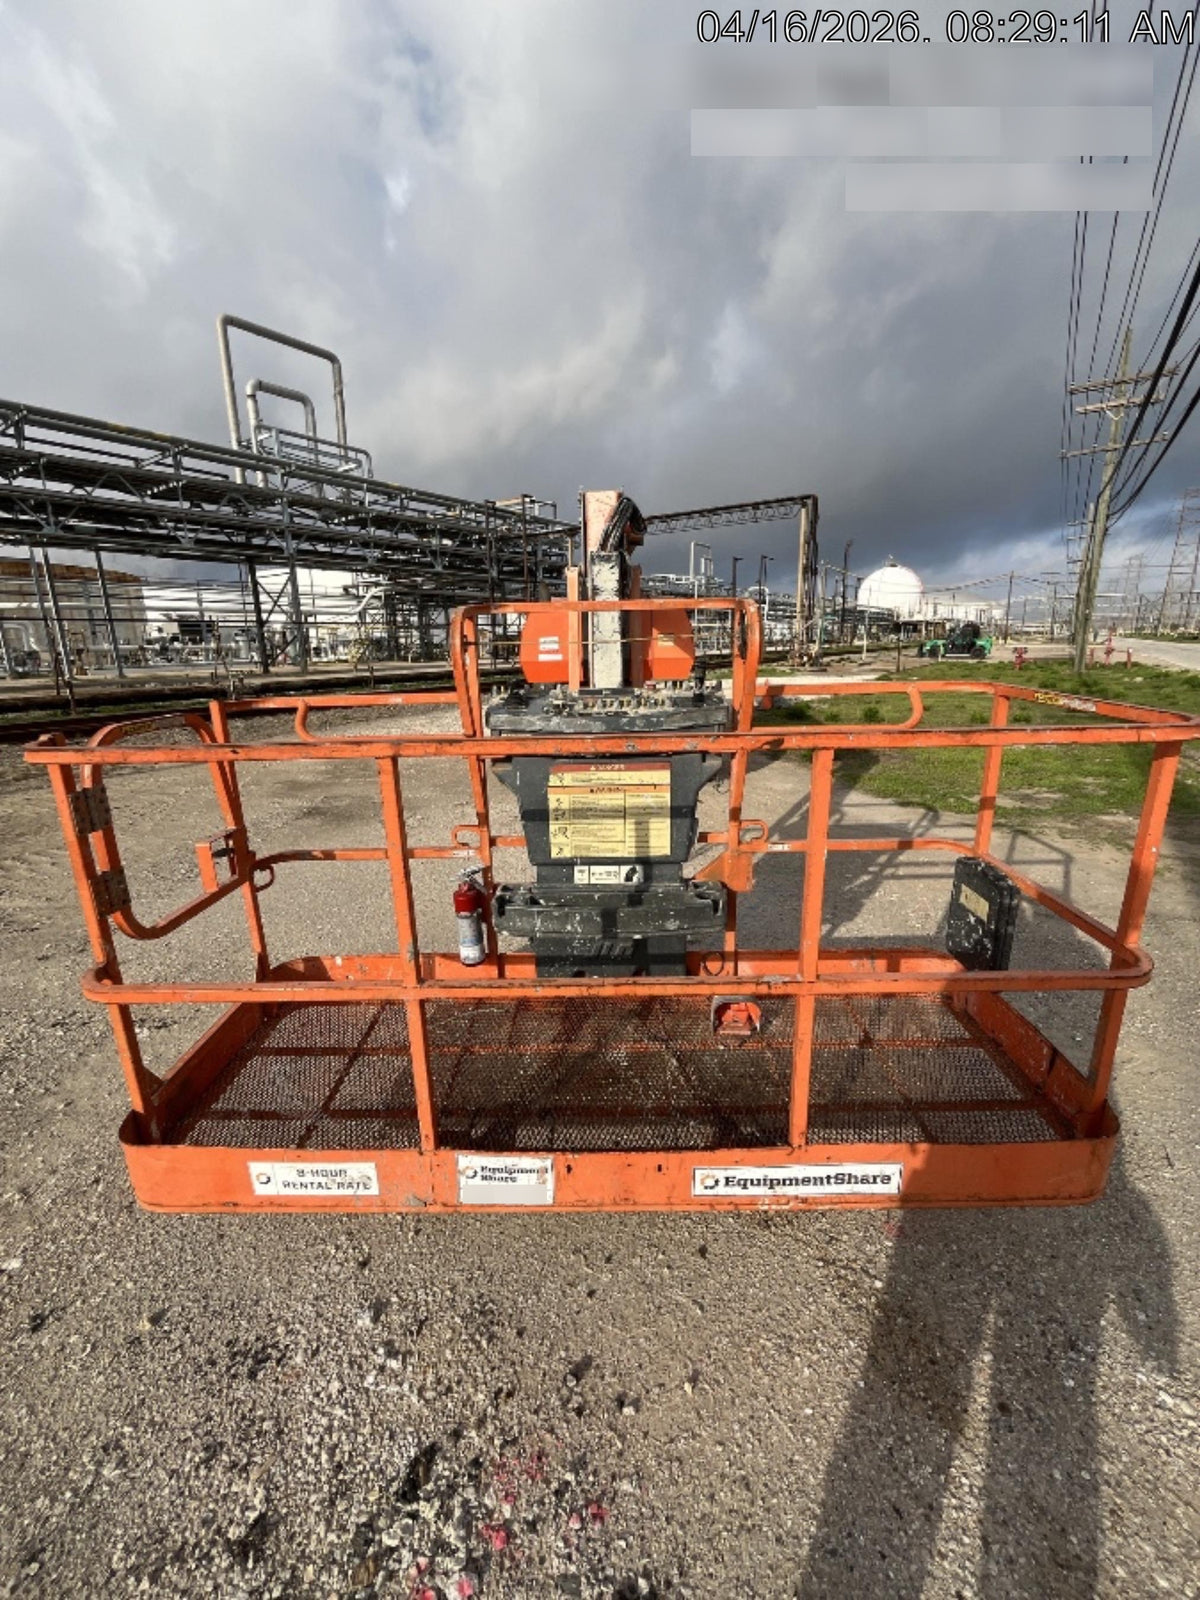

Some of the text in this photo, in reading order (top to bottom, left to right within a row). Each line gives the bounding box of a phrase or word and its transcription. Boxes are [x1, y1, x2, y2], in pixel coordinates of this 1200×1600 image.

[282, 1180, 372, 1190] RENTAL RATE
[723, 1172, 892, 1190] EquipmentShare
